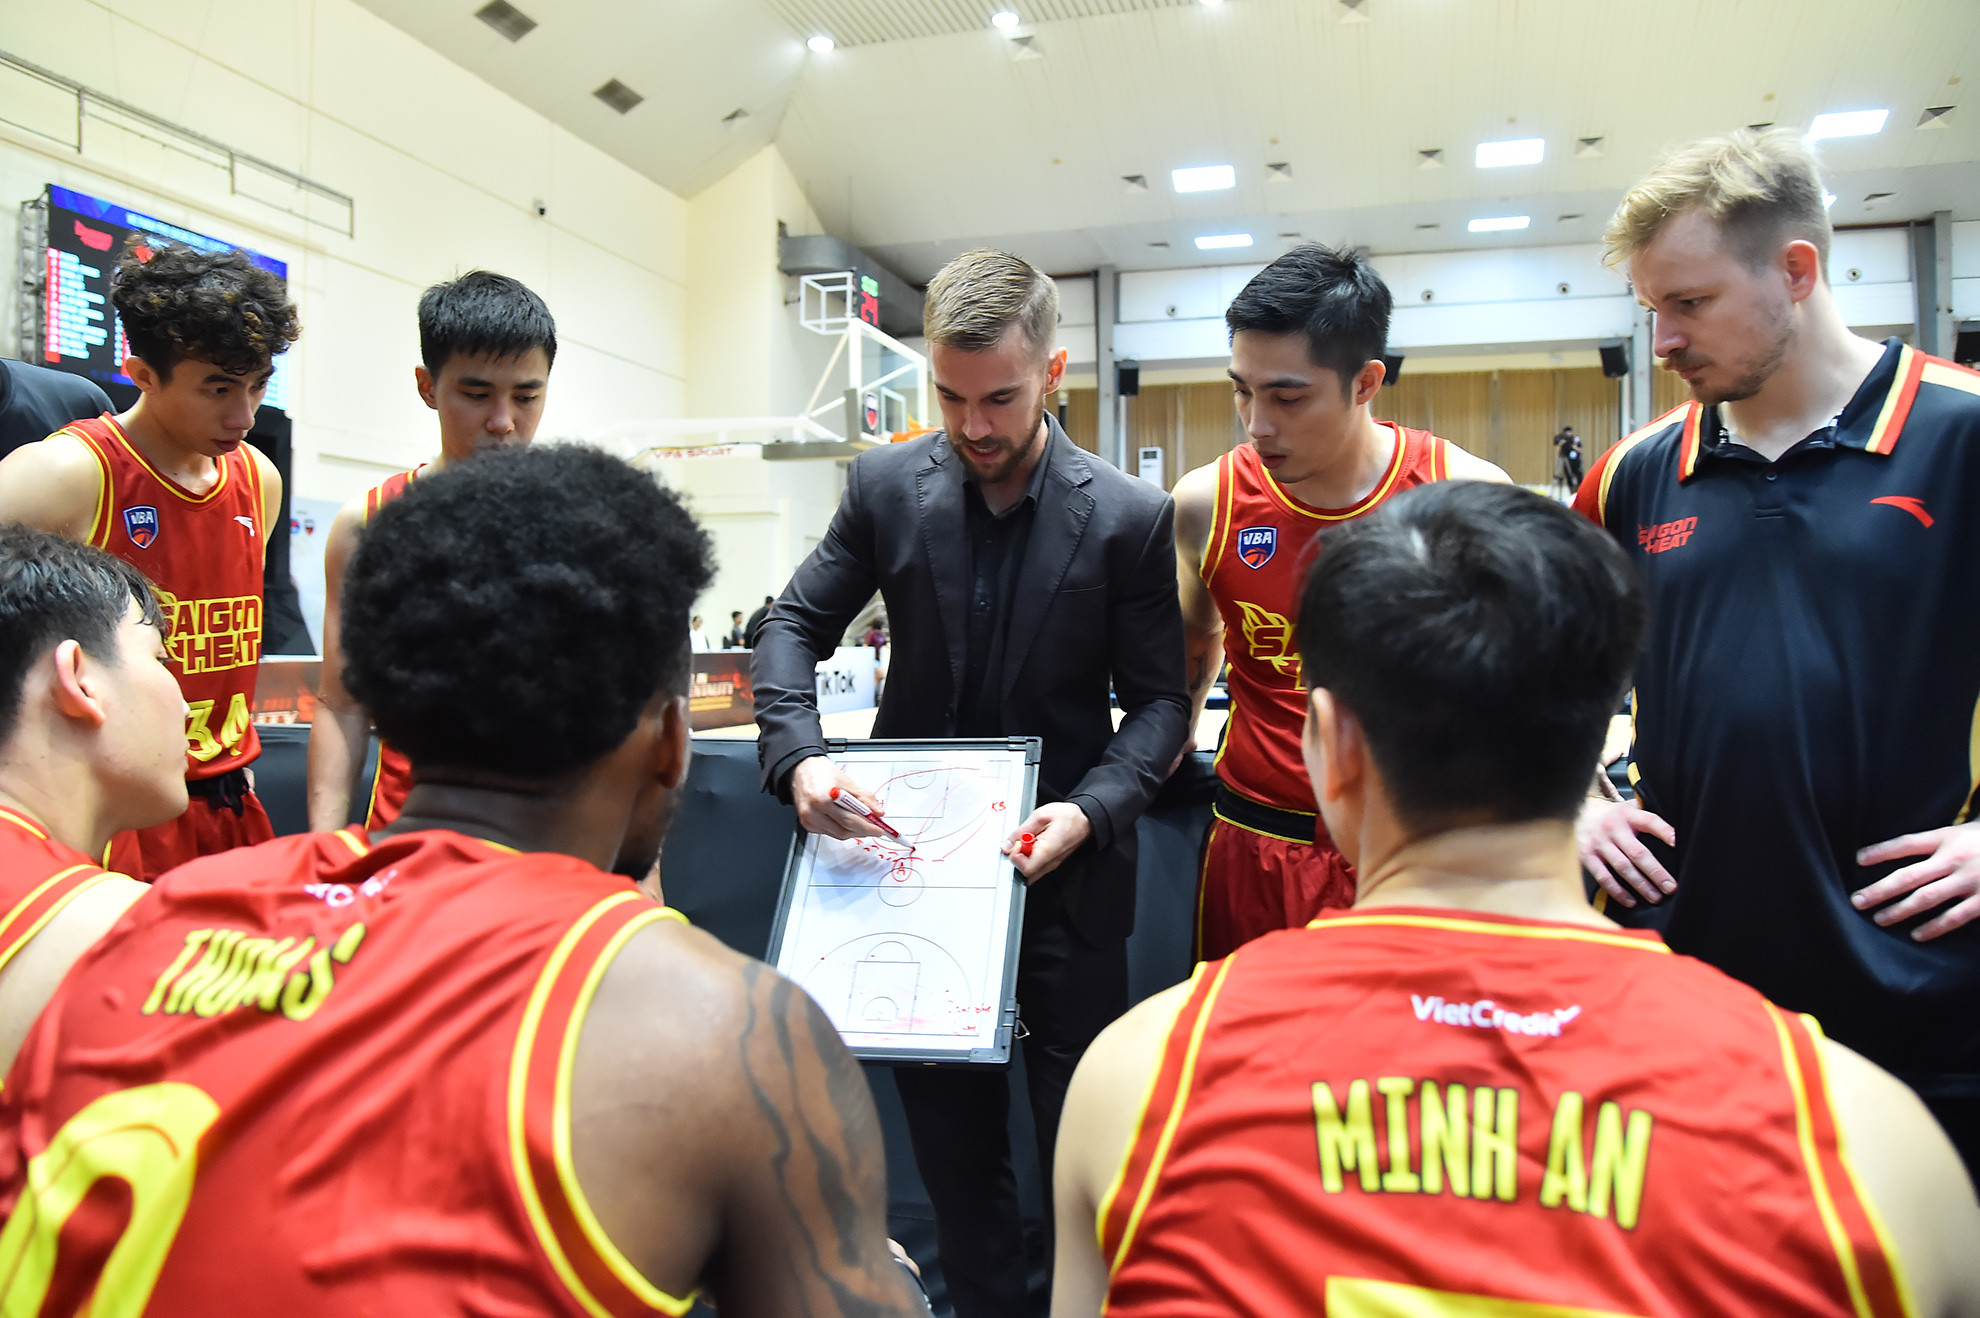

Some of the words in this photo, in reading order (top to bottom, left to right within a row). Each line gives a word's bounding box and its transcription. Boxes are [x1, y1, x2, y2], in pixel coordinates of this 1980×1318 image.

[130, 511, 155, 525] VBA
[1243, 531, 1272, 546] VBA
[182, 631, 262, 675] HEAT
[1411, 994, 1562, 1037] VietCredit
[1311, 1076, 1519, 1203] MINH
[1540, 1090, 1653, 1231] AN
